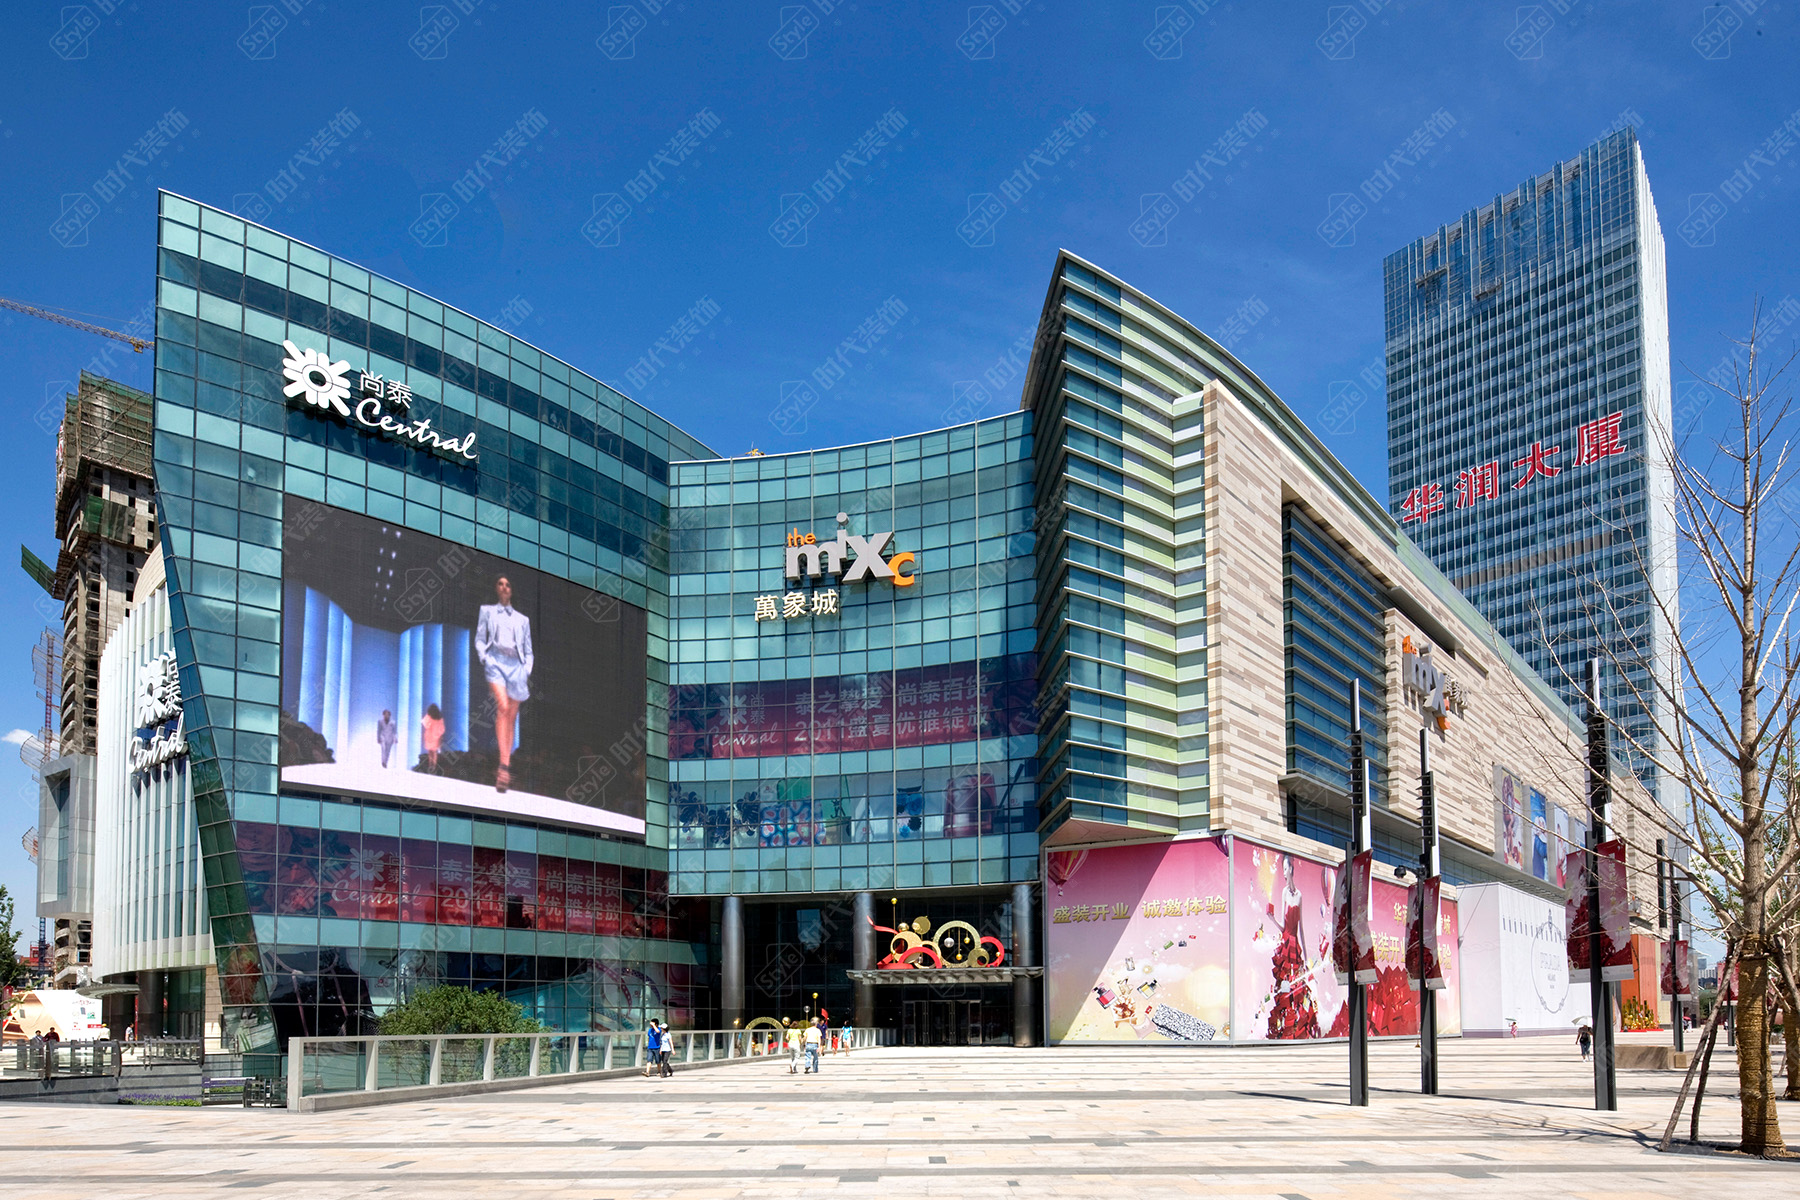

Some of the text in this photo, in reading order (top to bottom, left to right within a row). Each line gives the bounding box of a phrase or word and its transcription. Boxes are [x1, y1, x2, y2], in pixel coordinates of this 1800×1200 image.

[360, 368, 413, 409] 尚泰
[355, 397, 477, 459] Central
[1401, 411, 1627, 524] 华润大厦
[787, 527, 816, 548] the
[754, 588, 838, 622] 萬象城
[163, 647, 183, 715] 尚泰
[898, 675, 988, 706] 尚泰百货
[896, 702, 988, 734] 优雅绽放
[128, 711, 188, 774] Central
[708, 723, 778, 748] Central
[331, 879, 423, 906] Central
[544, 870, 620, 899] 尚泰百货
[543, 895, 620, 921] 优雅绽放
[1052, 894, 1227, 924] 盛装开业 诚邀体验
